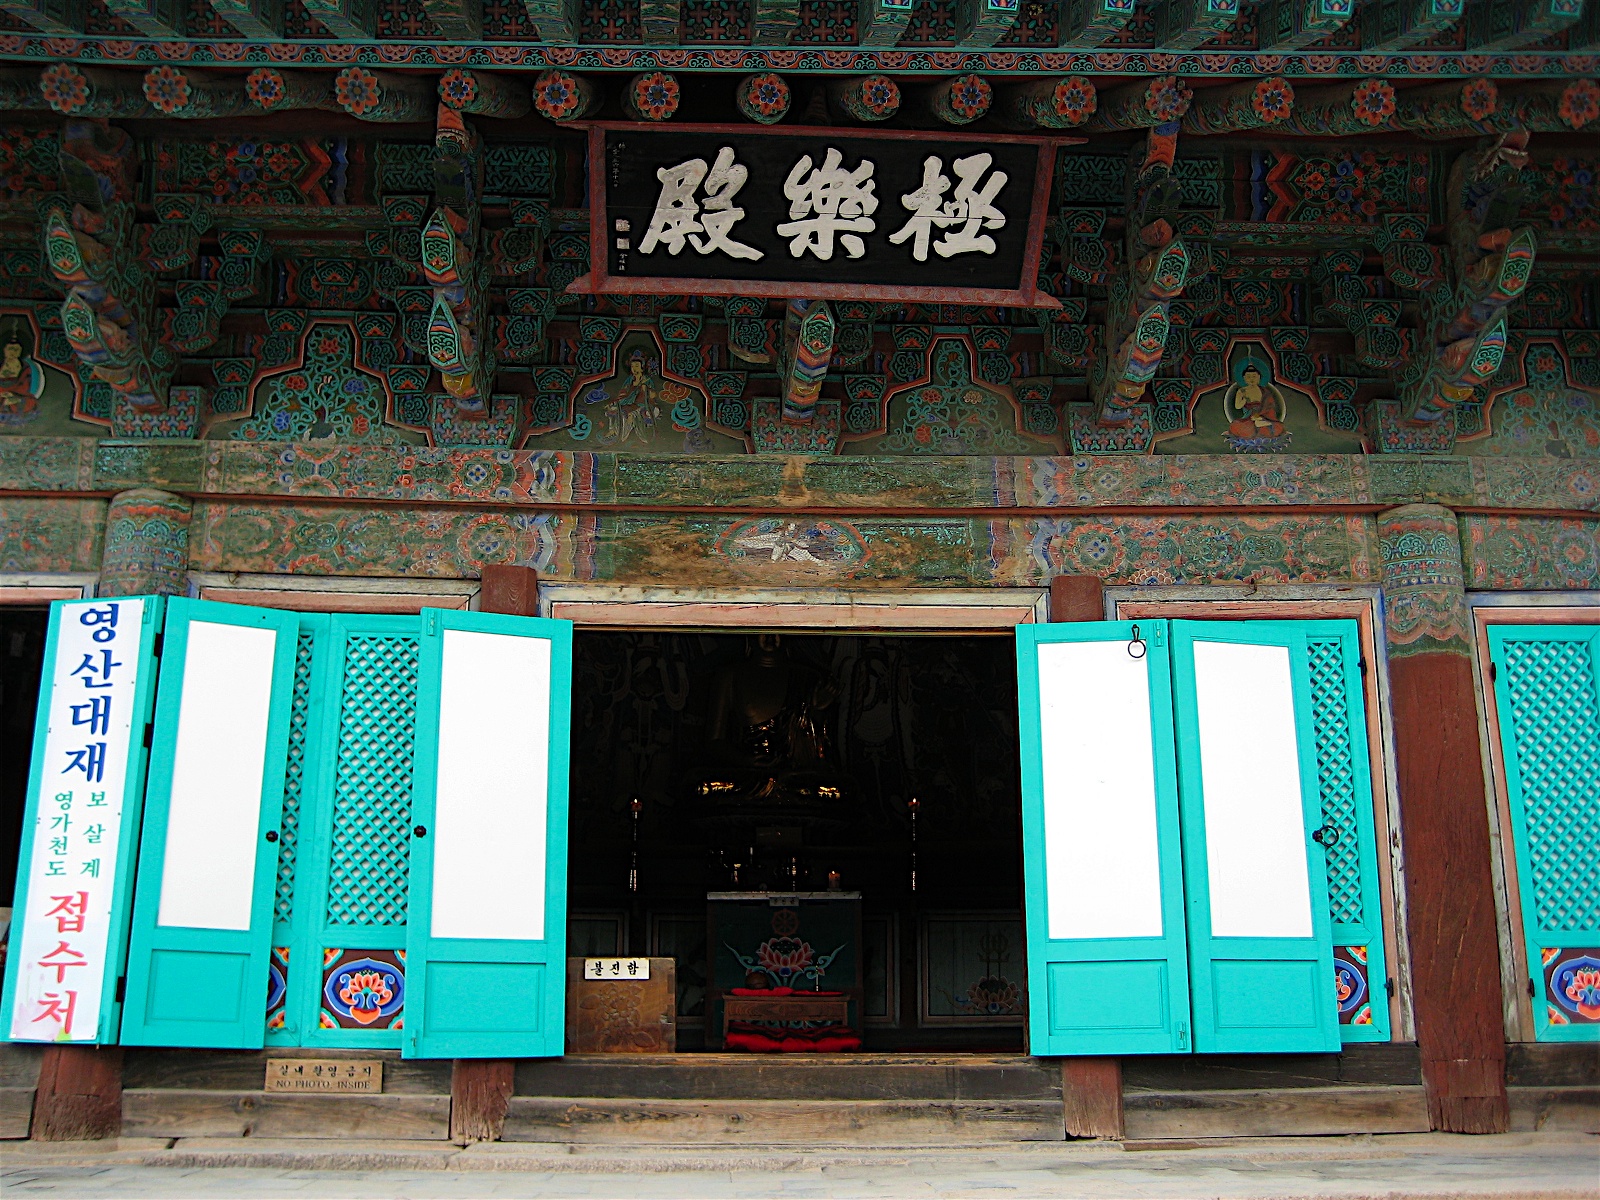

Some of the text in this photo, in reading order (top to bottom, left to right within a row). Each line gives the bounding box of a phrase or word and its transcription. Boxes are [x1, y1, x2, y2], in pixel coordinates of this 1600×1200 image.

[61, 602, 123, 784] 영산대재
[44, 790, 75, 878] 영가천도
[80, 791, 108, 879] 보살계
[31, 890, 89, 1035] 접수처
[276, 1079, 291, 1089] NO
[337, 1080, 371, 1090] INSIDE
[345, 1065, 372, 1078] 금지
